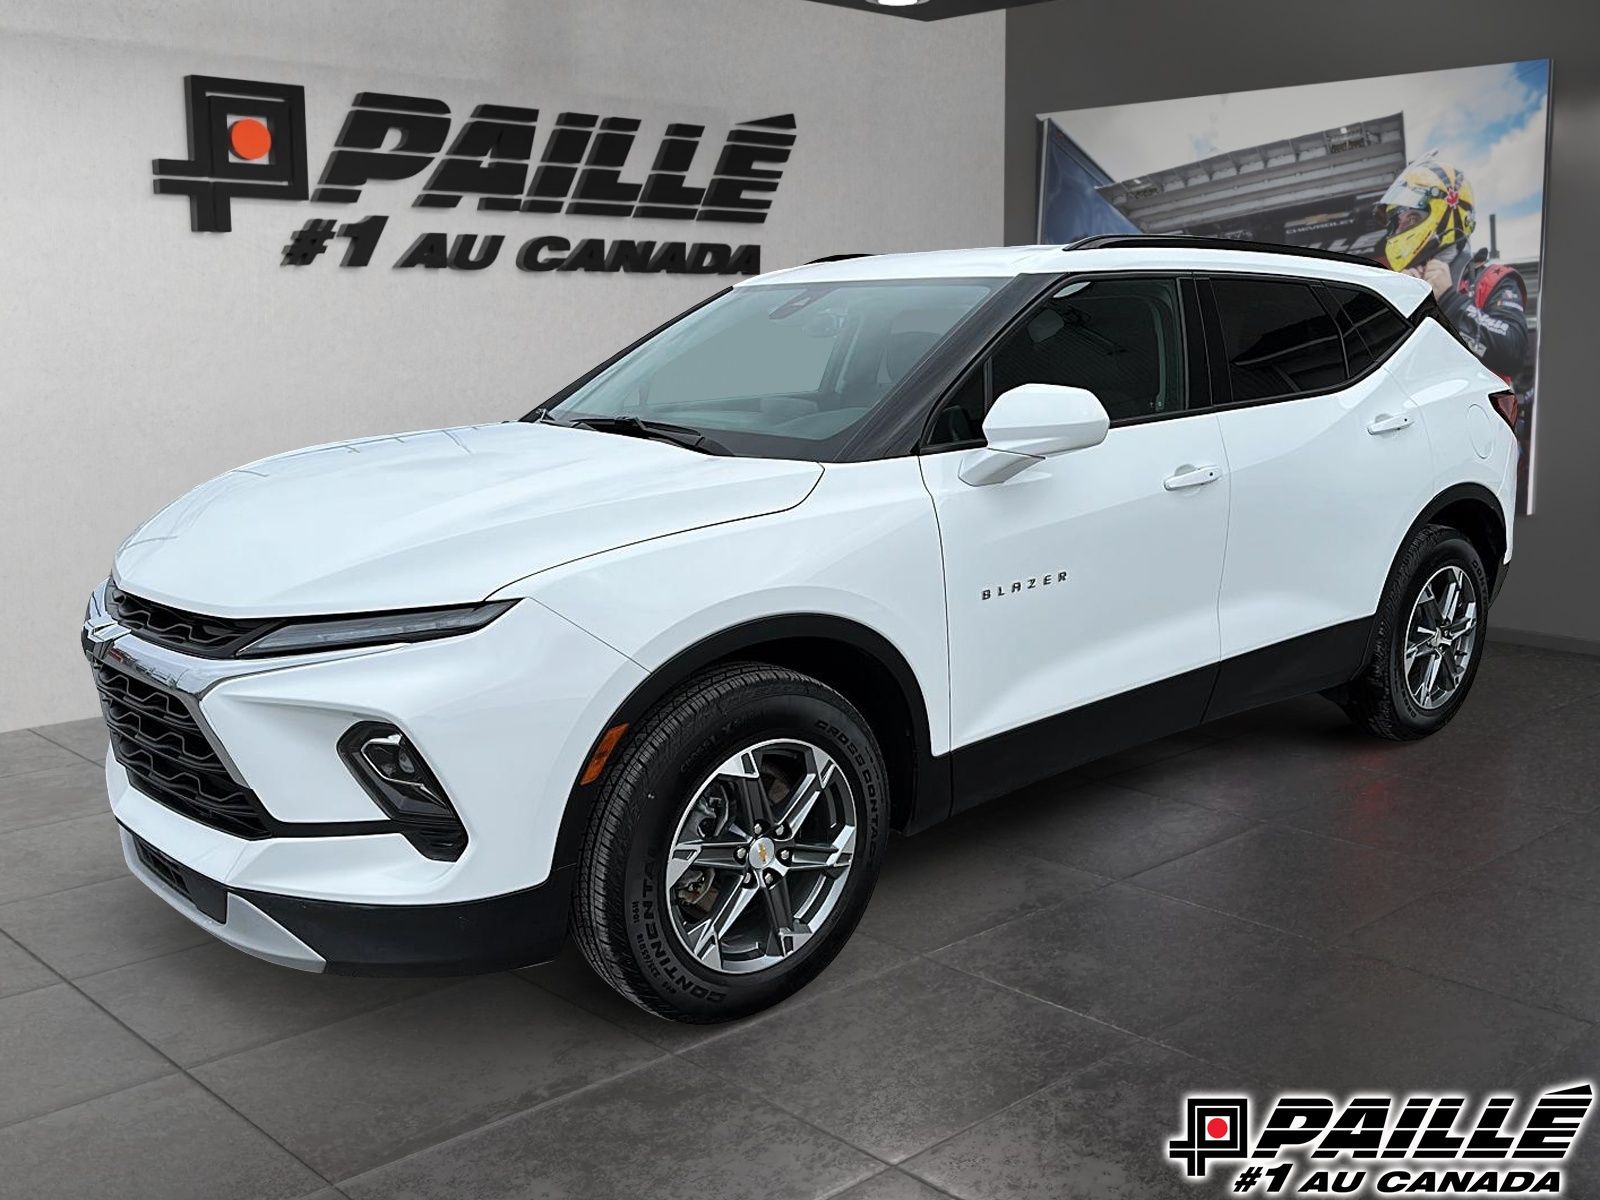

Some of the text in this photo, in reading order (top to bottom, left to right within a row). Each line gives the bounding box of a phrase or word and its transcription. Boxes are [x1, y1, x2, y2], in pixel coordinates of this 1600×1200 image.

[309, 91, 797, 224] PAILLÉ
[280, 215, 761, 276] #1 AU CANADA
[981, 571, 1067, 601] BLAZER
